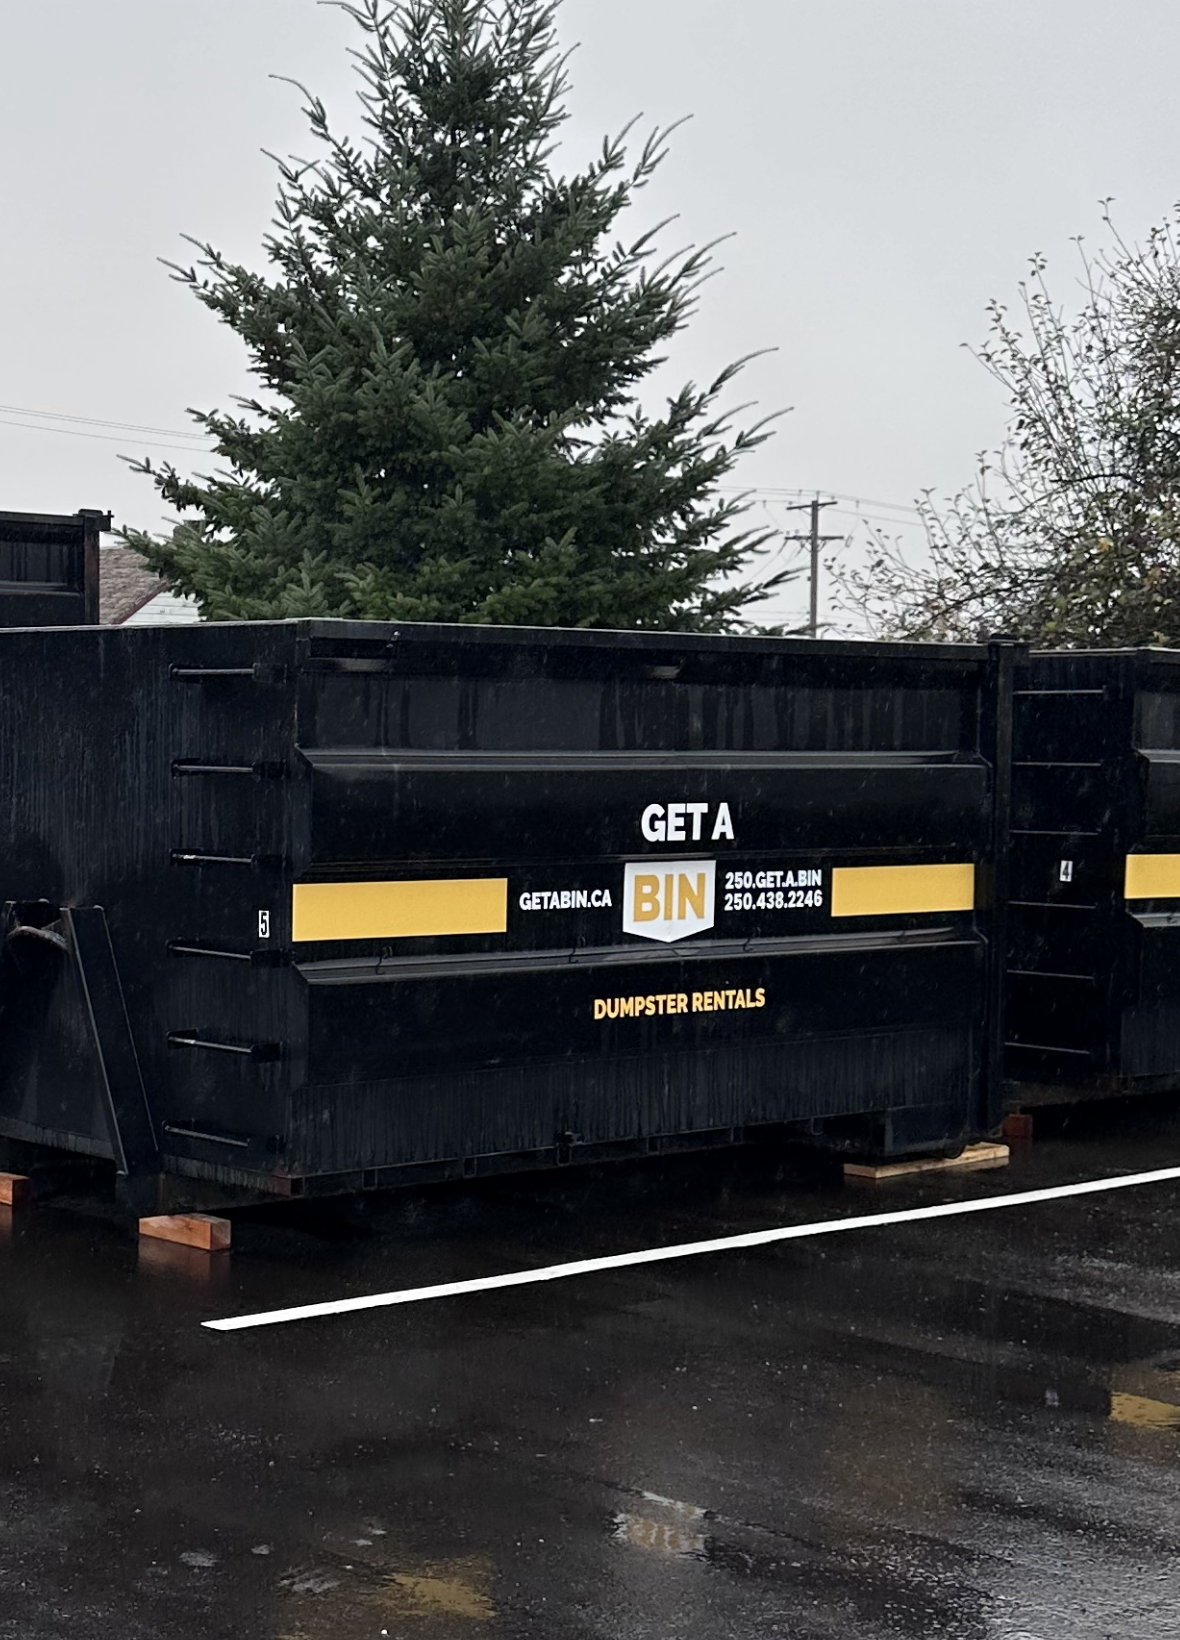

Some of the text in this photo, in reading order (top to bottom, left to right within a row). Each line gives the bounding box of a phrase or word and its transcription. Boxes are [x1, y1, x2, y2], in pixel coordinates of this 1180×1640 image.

[641, 802, 735, 842] GET A
[725, 869, 822, 890] 250.GET.A.BIN
[1062, 862, 1070, 880] 4
[519, 889, 613, 911] GETABIN.CA
[633, 872, 706, 922] BIN
[724, 889, 823, 911] 250.438.2246
[260, 911, 267, 936] 5
[593, 988, 766, 1020] DUMPSTER RENTALS
